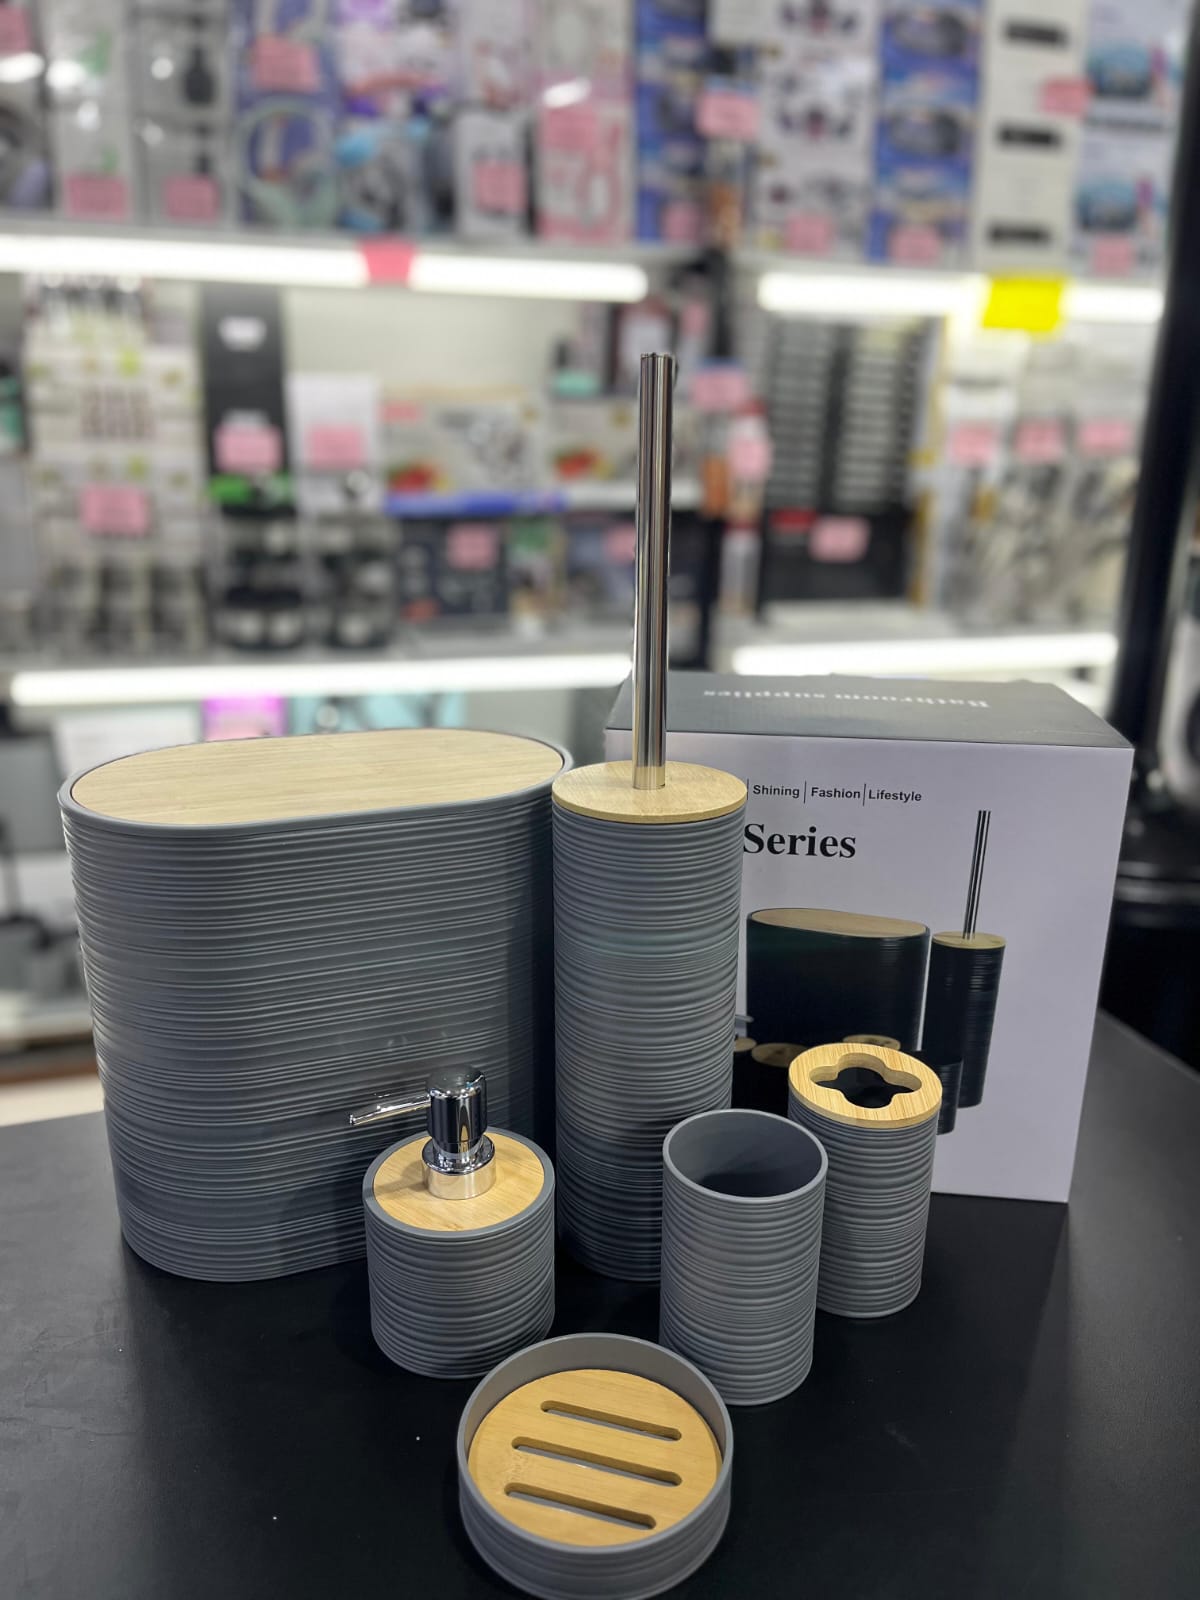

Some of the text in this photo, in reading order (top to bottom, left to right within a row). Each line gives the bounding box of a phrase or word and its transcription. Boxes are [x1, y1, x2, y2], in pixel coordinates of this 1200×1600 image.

[752, 784, 922, 803] Shining Fashion Lifestyle
[743, 823, 856, 859] Series
